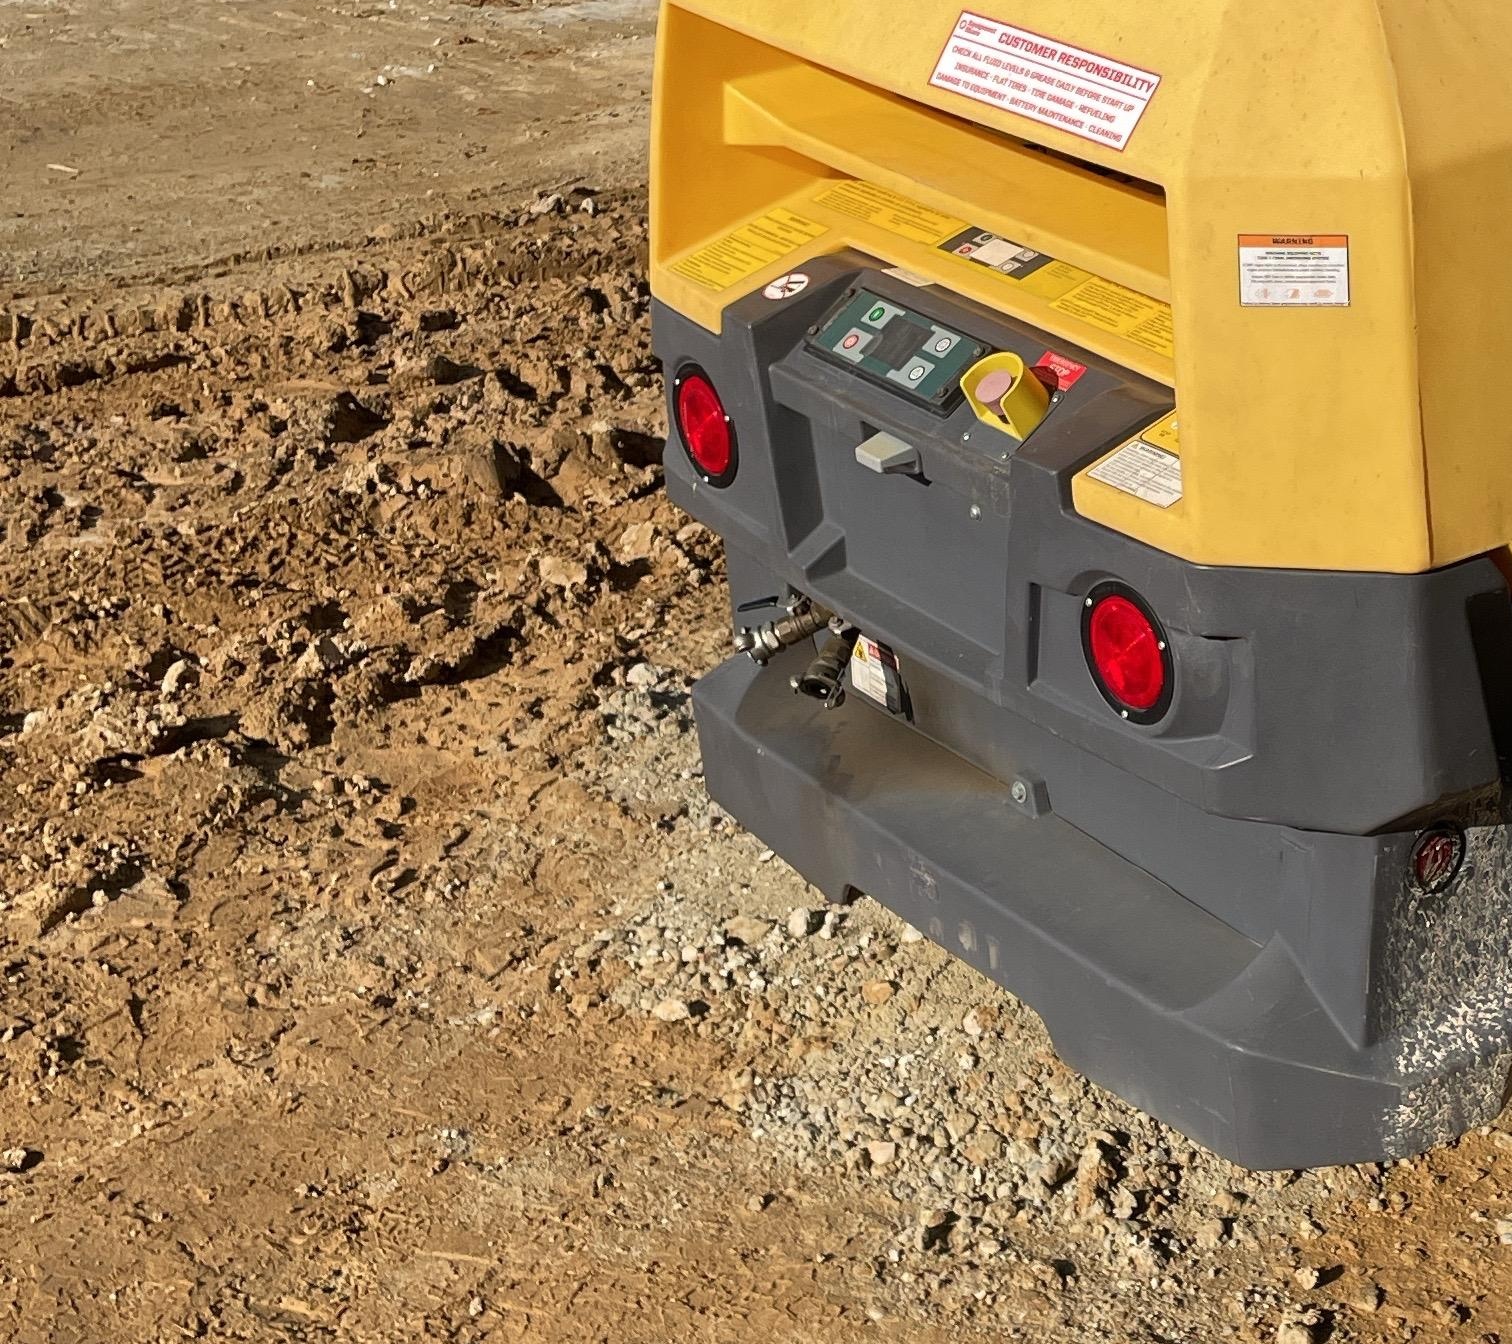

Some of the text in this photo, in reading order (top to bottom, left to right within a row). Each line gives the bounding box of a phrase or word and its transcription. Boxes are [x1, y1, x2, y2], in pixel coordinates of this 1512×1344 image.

[998, 32, 1155, 93] CUSTOMER RESPONSIBILITY
[1001, 61, 1025, 75] LEVELS
[1030, 71, 1056, 86] GREASE
[1075, 86, 1102, 102] BEFORE
[1101, 96, 1124, 110] START
[954, 62, 990, 79] INSURANCE
[1078, 104, 1116, 123] REFUELING
[1009, 97, 1038, 113] BATTERY
[1037, 106, 1086, 129] MAINTENANCE
[1088, 124, 1123, 142] CLEANING
